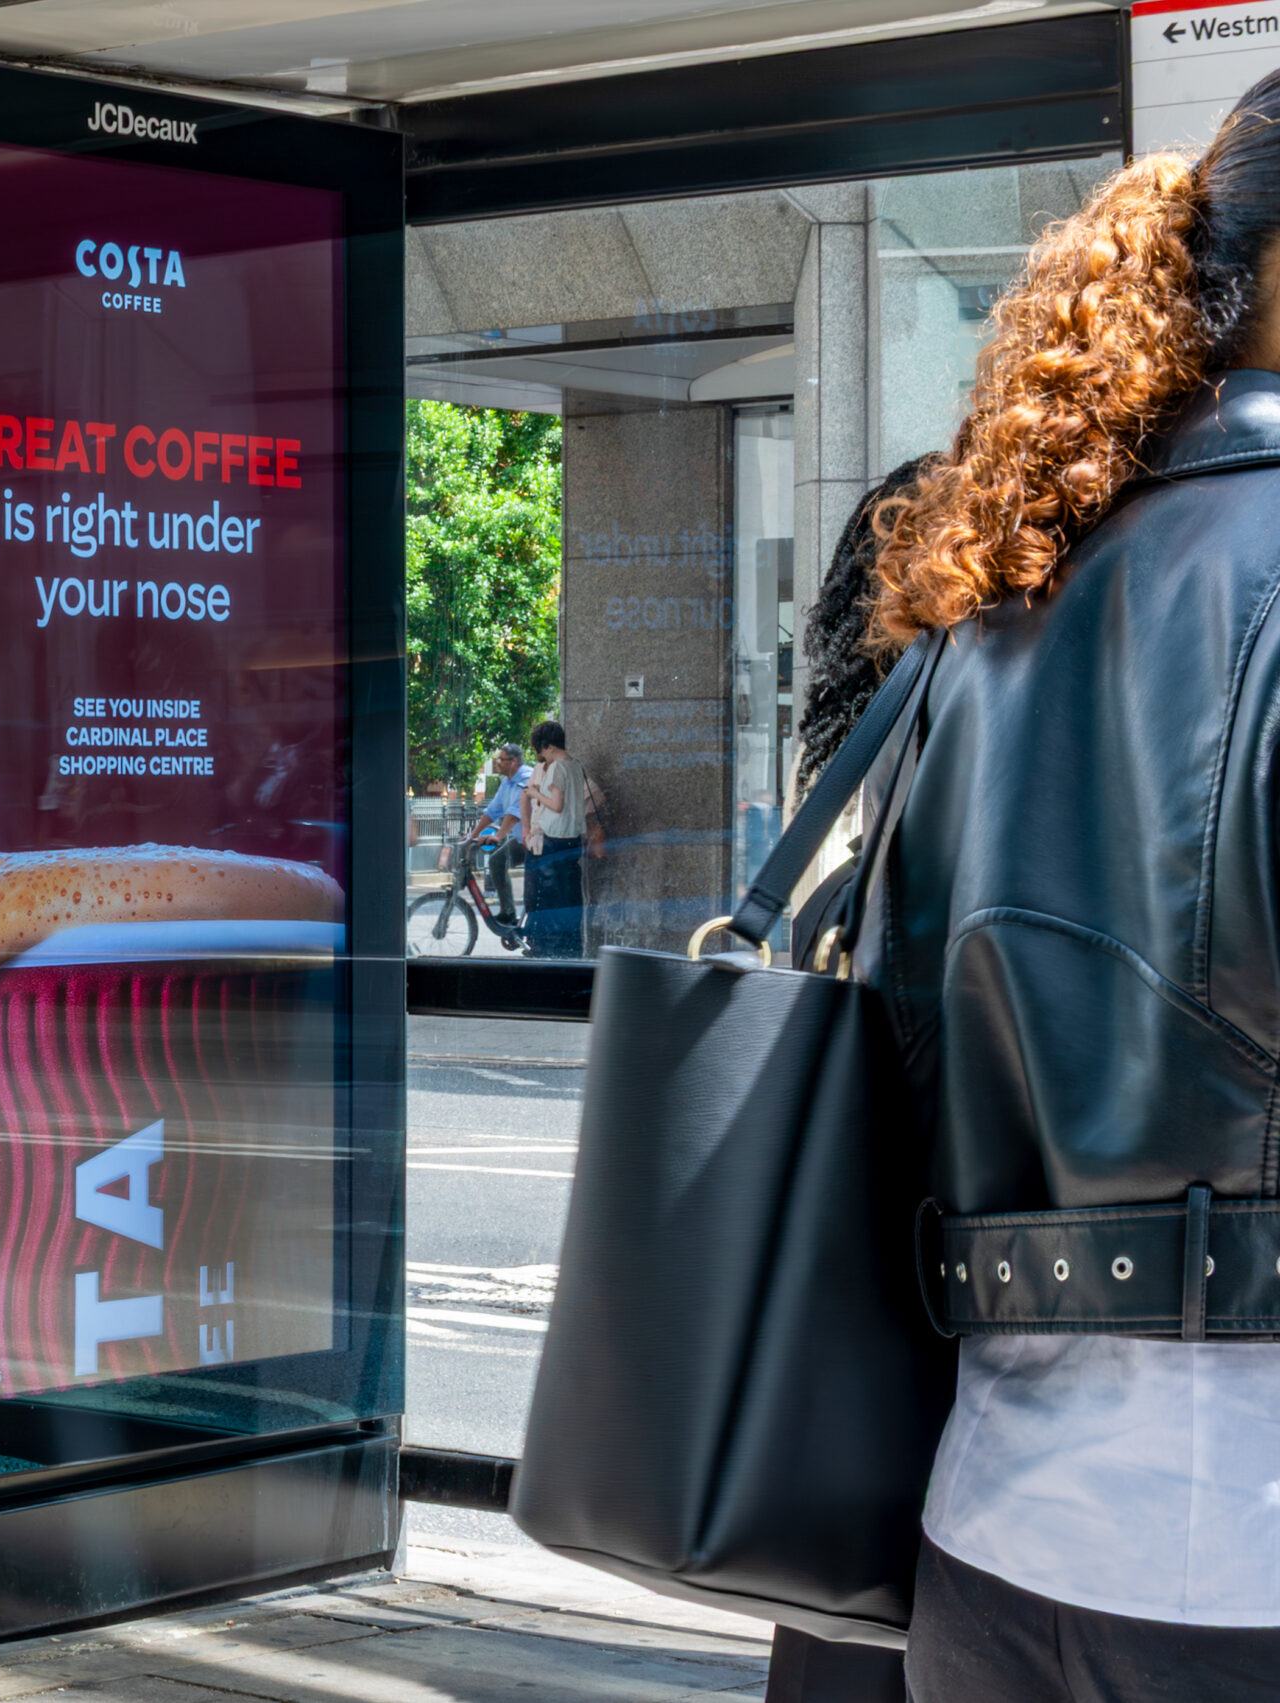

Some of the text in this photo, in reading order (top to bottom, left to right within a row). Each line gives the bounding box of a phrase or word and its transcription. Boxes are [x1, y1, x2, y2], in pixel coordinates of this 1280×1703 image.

[1190, 15, 1278, 41] Westm
[87, 101, 198, 145] JCDecaux
[74, 238, 187, 289] COSTA
[101, 291, 162, 314] COFFEE
[123, 424, 302, 489] COFFEE
[4, 488, 261, 559] is right under
[35, 574, 231, 628] your nose
[73, 697, 201, 720] SEE YOU INSIDE
[65, 726, 208, 748] CARDINAL PLACE
[59, 756, 214, 777] SHOPPING CENTRE
